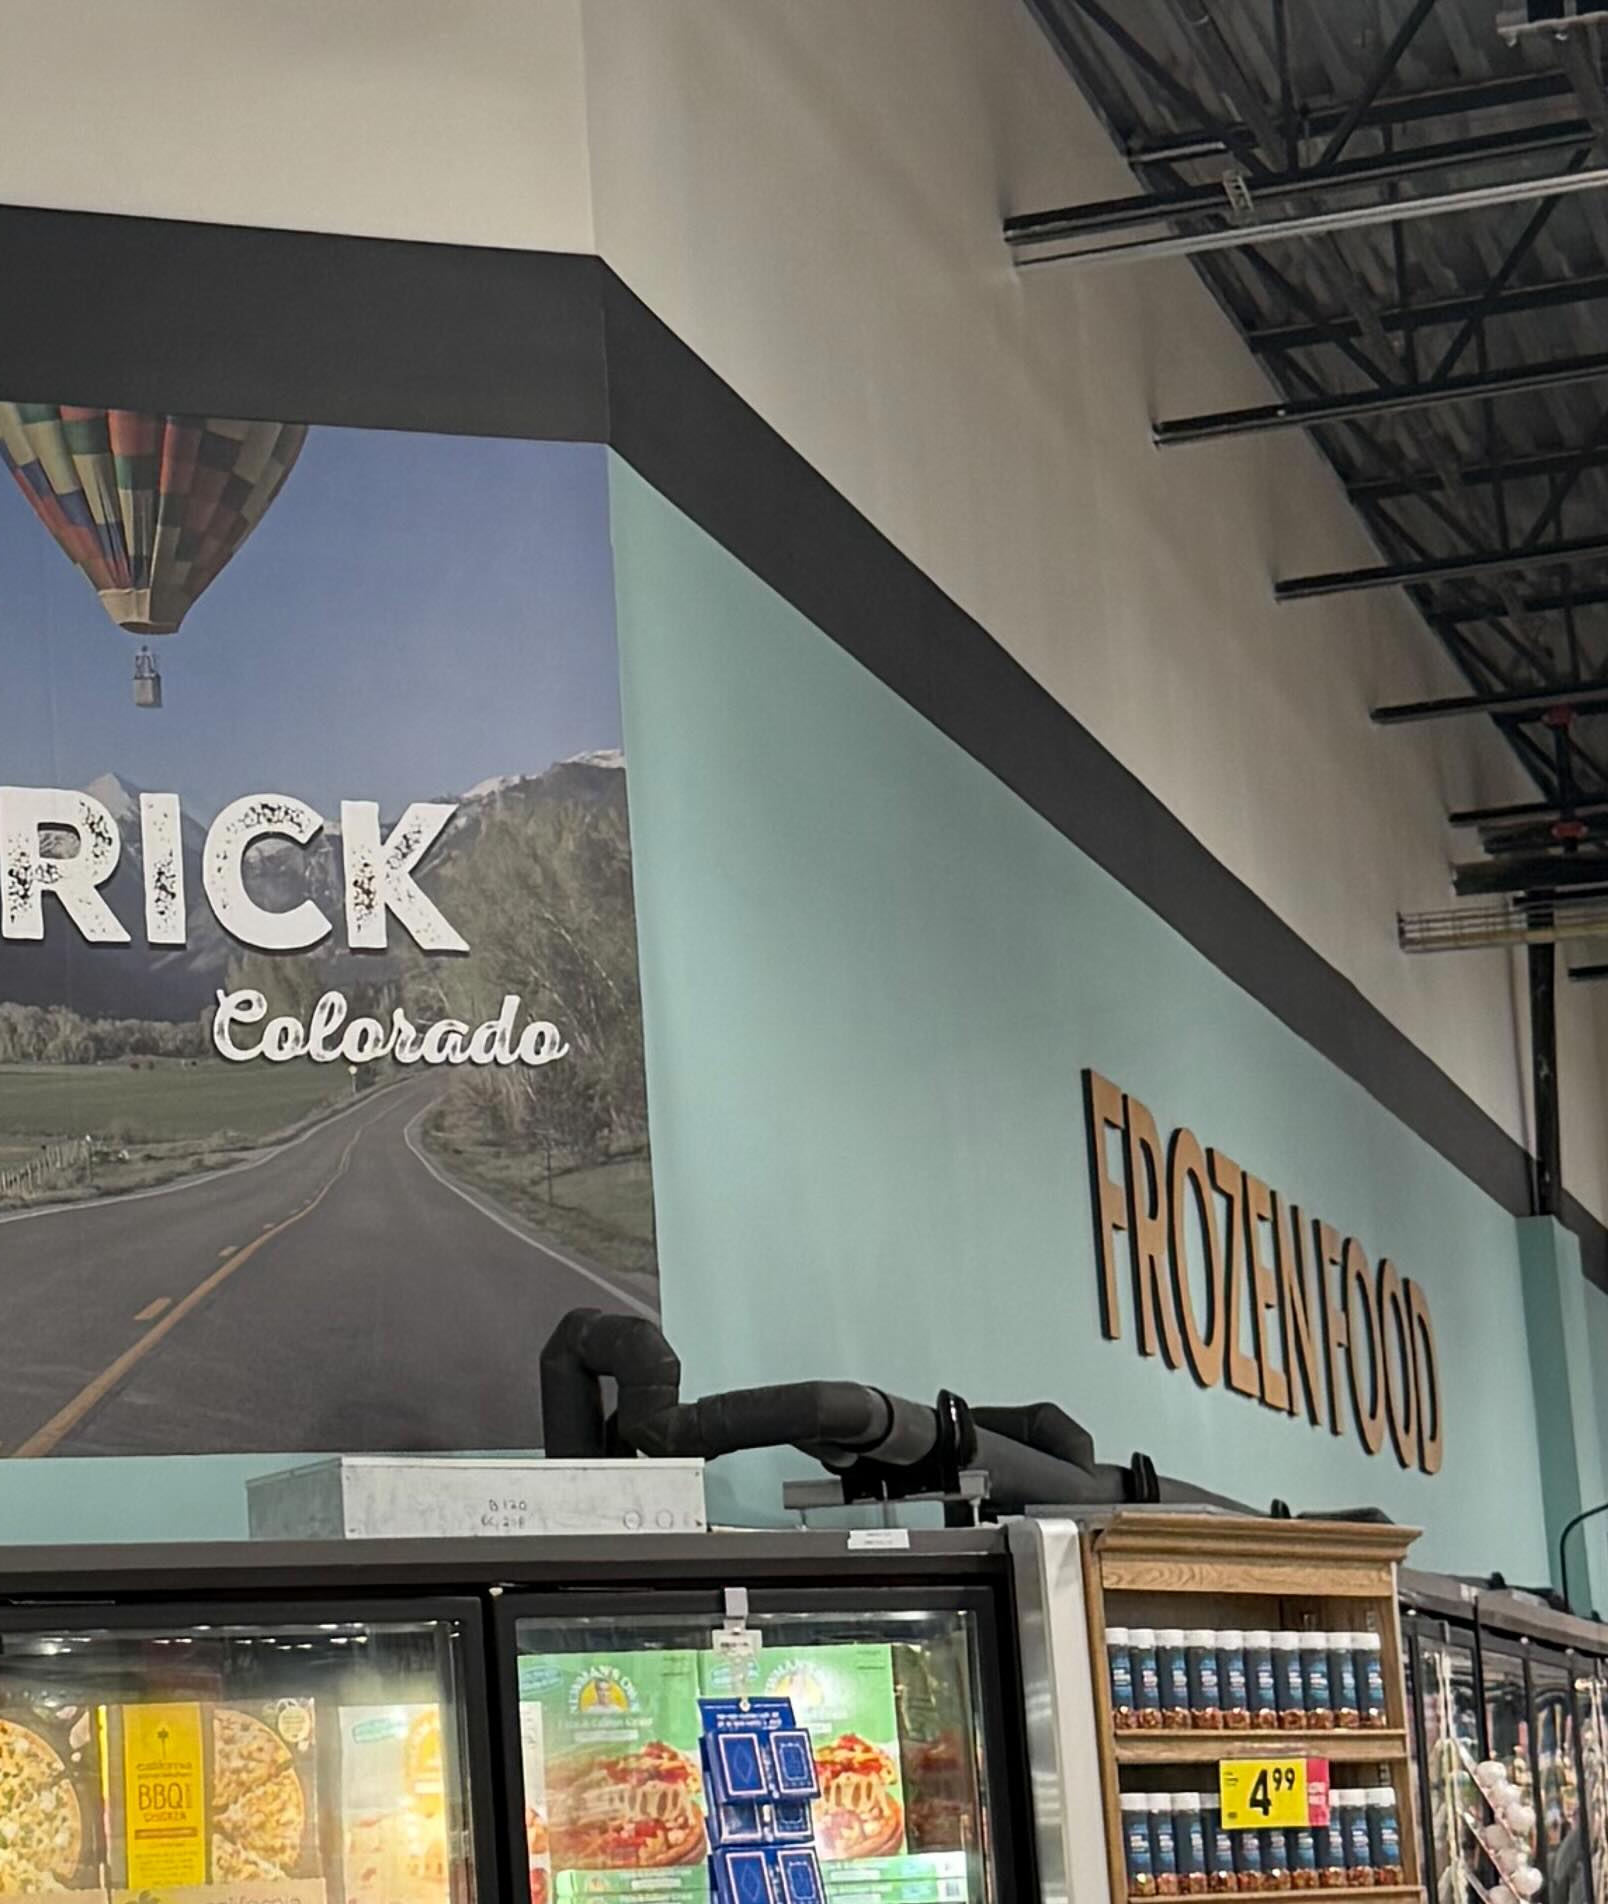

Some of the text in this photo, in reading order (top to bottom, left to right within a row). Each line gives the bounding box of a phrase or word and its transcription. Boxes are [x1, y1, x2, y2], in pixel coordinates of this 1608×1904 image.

[211, 990, 569, 1068] Colorado
[1082, 1068, 1442, 1475] FROZEN FOOD
[136, 1761, 192, 1771] california
[137, 1784, 184, 1811] BBQ
